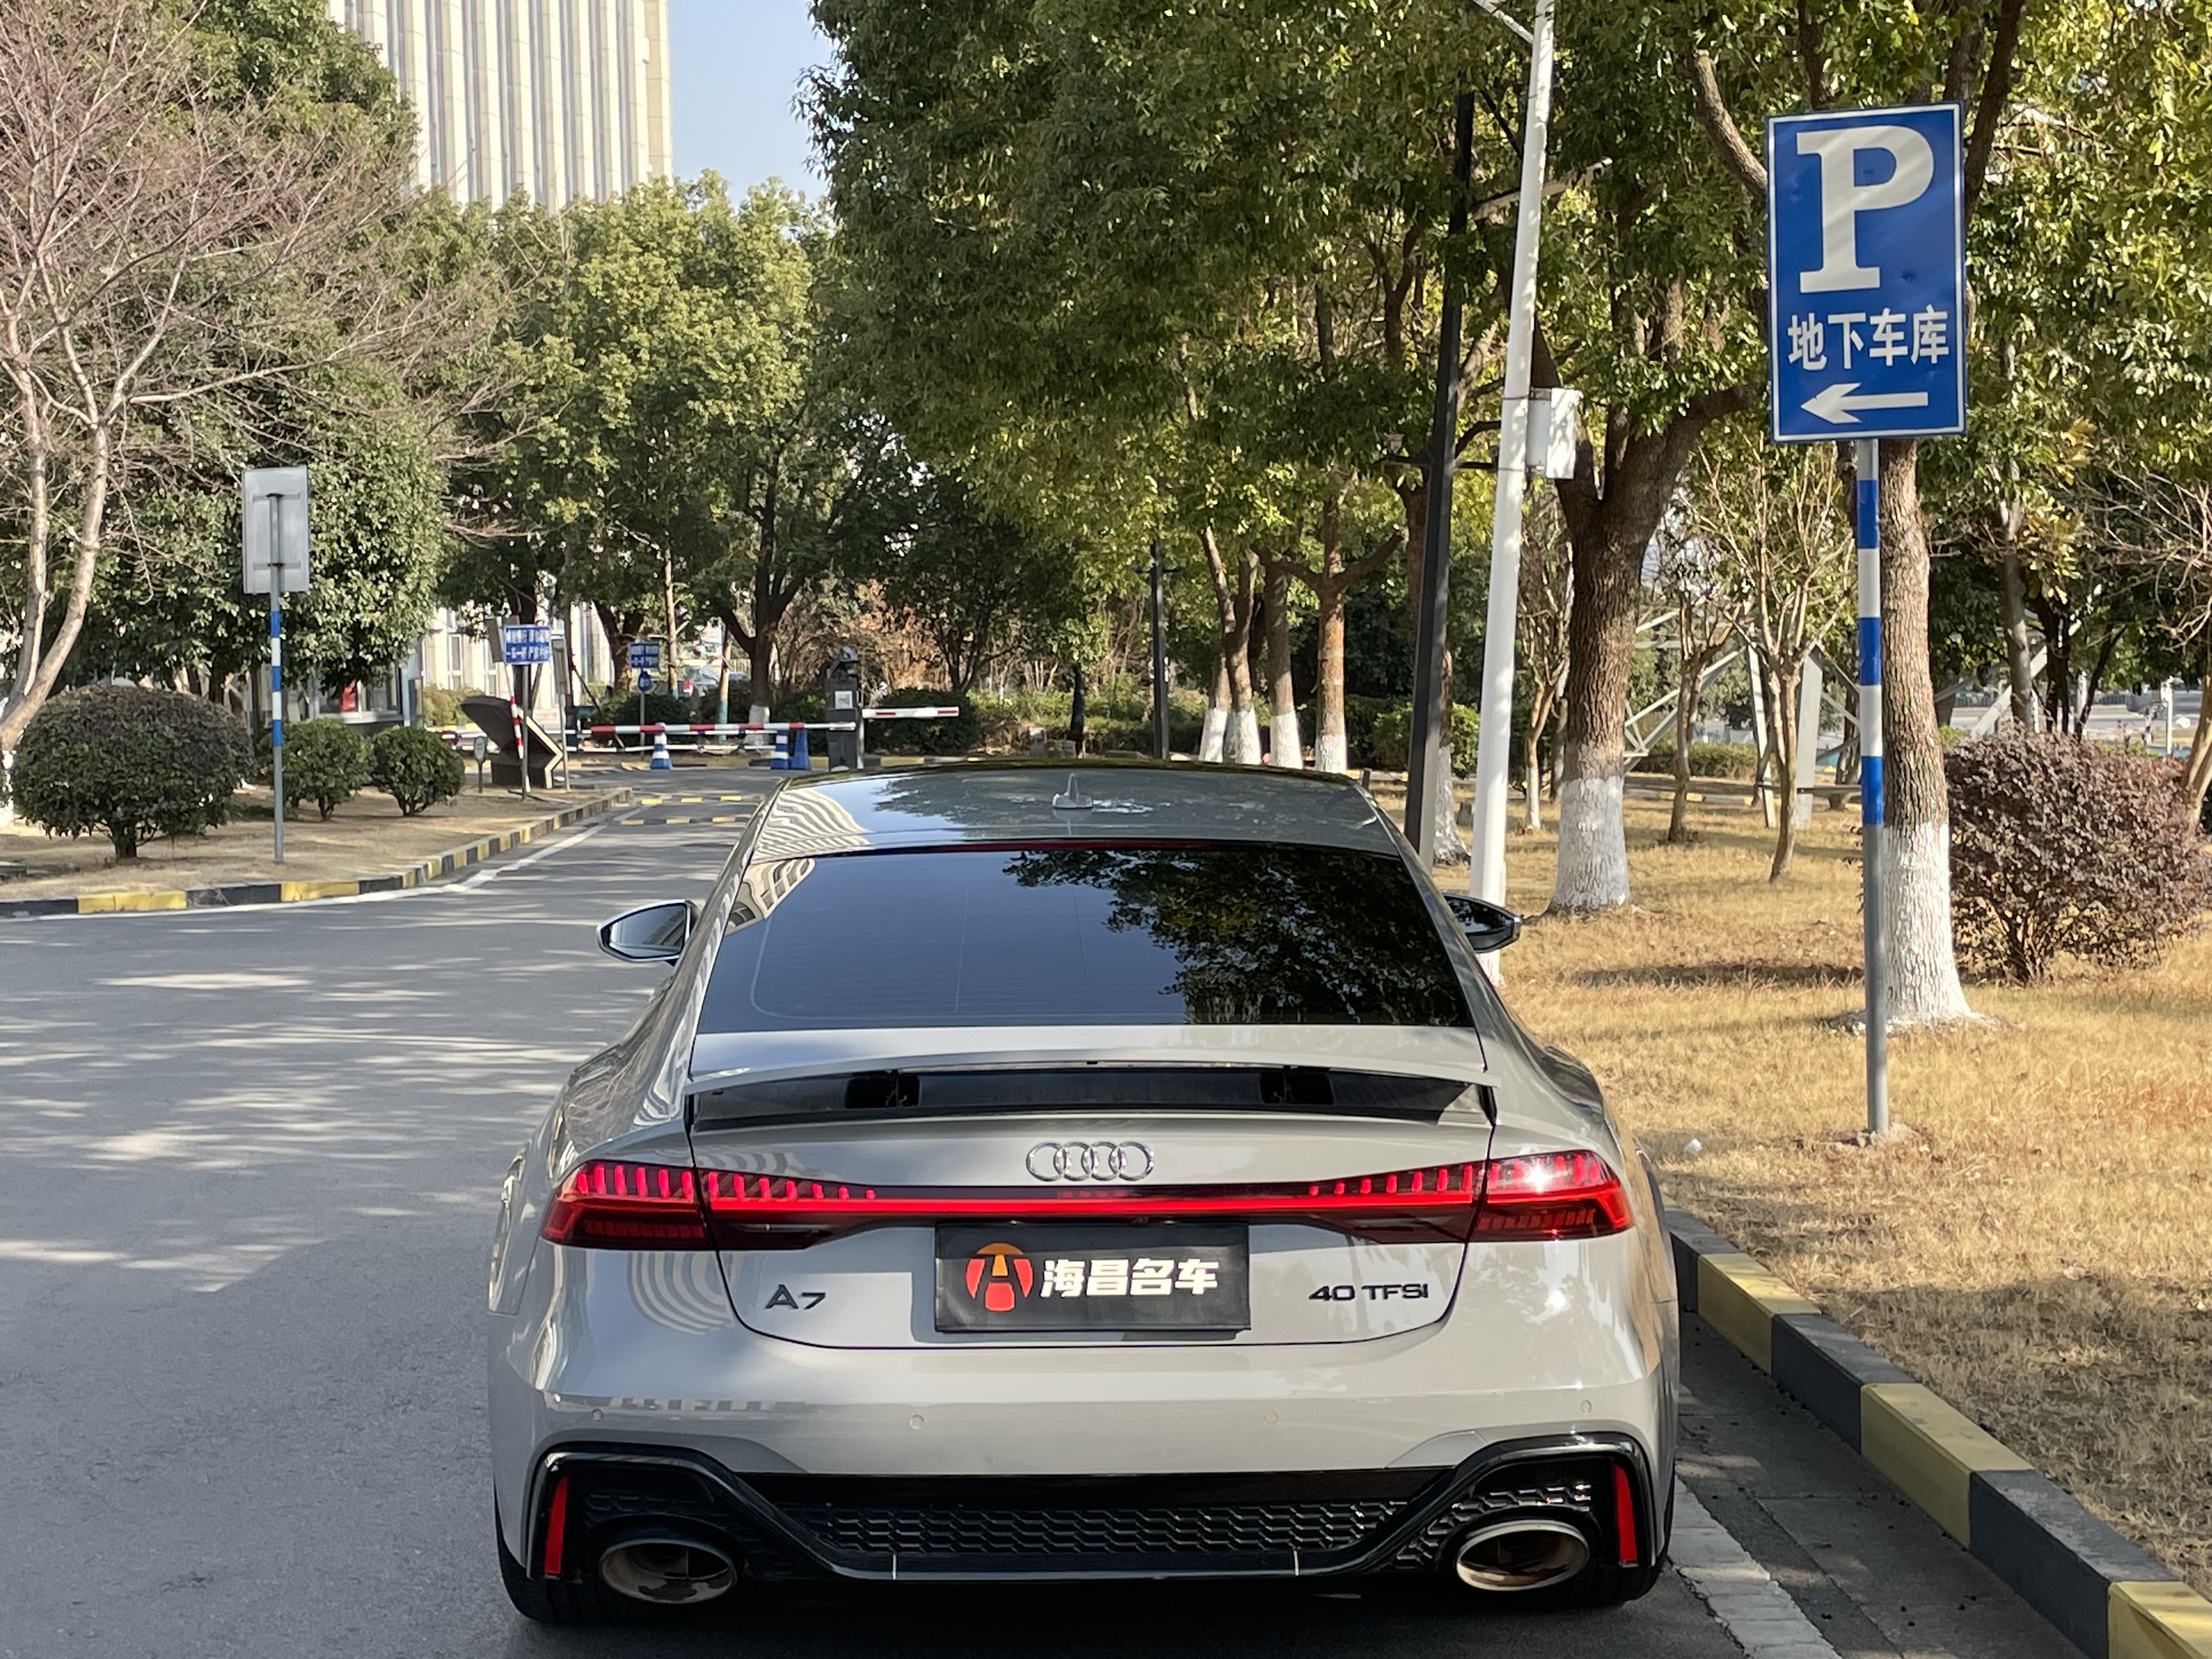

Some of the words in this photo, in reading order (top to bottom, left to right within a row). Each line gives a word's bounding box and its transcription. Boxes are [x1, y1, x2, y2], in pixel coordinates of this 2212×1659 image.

[1797, 126, 1934, 293] P
[1788, 304, 1949, 370] 地下车库
[765, 1284, 826, 1310] A7
[1041, 1257, 1219, 1297] 海昌名车
[1308, 1285, 1355, 1301] 40
[1361, 1283, 1429, 1300] TFSI
